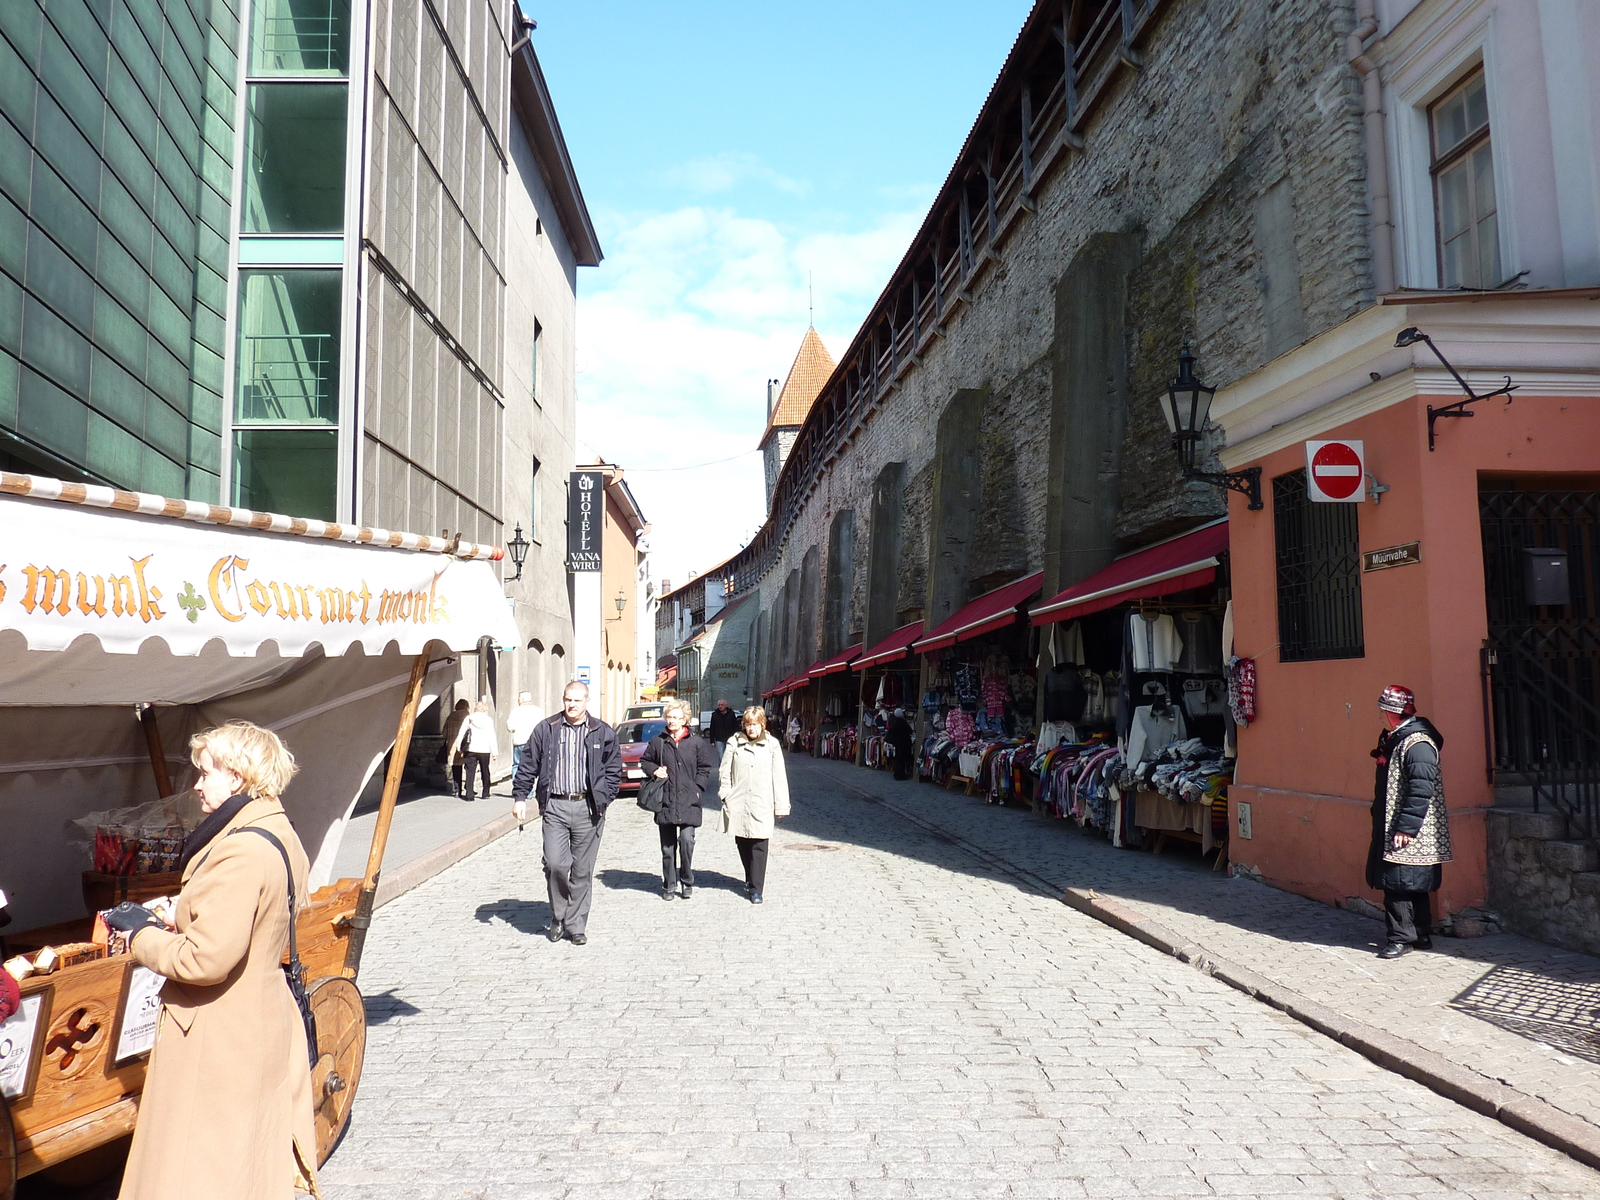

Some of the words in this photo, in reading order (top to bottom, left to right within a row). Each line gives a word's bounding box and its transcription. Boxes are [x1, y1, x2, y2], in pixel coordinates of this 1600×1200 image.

[581, 492, 592, 550] HOTELL
[570, 552, 601, 561] VANA
[1372, 549, 1408, 565] Müürivahe
[571, 561, 601, 570] WIRU
[20, 554, 166, 623] munk
[376, 570, 452, 626] monk
